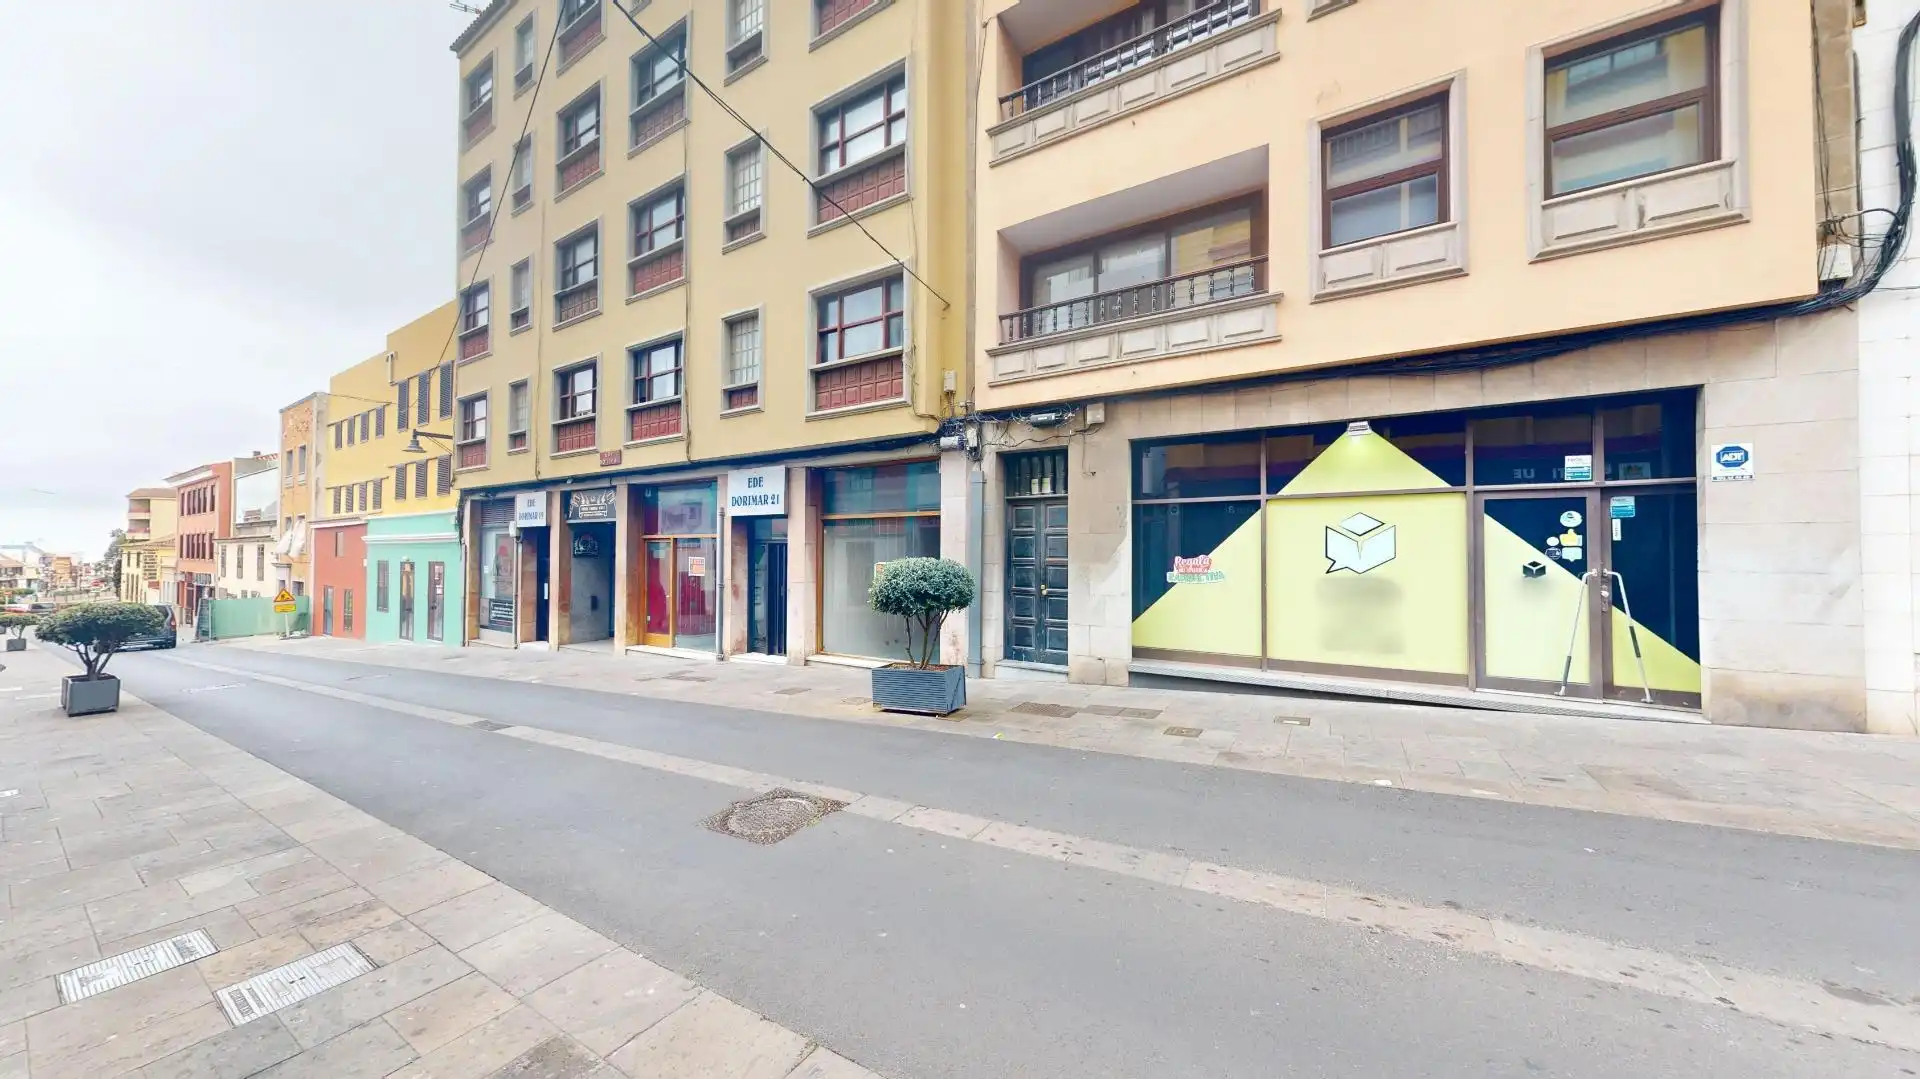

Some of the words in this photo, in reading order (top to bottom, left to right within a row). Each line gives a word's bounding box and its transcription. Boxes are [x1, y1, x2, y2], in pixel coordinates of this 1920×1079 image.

[1720, 452, 1744, 462] ADT
[747, 476, 764, 489] EDE
[731, 494, 769, 507] DORIMAR
[770, 493, 780, 505] 21
